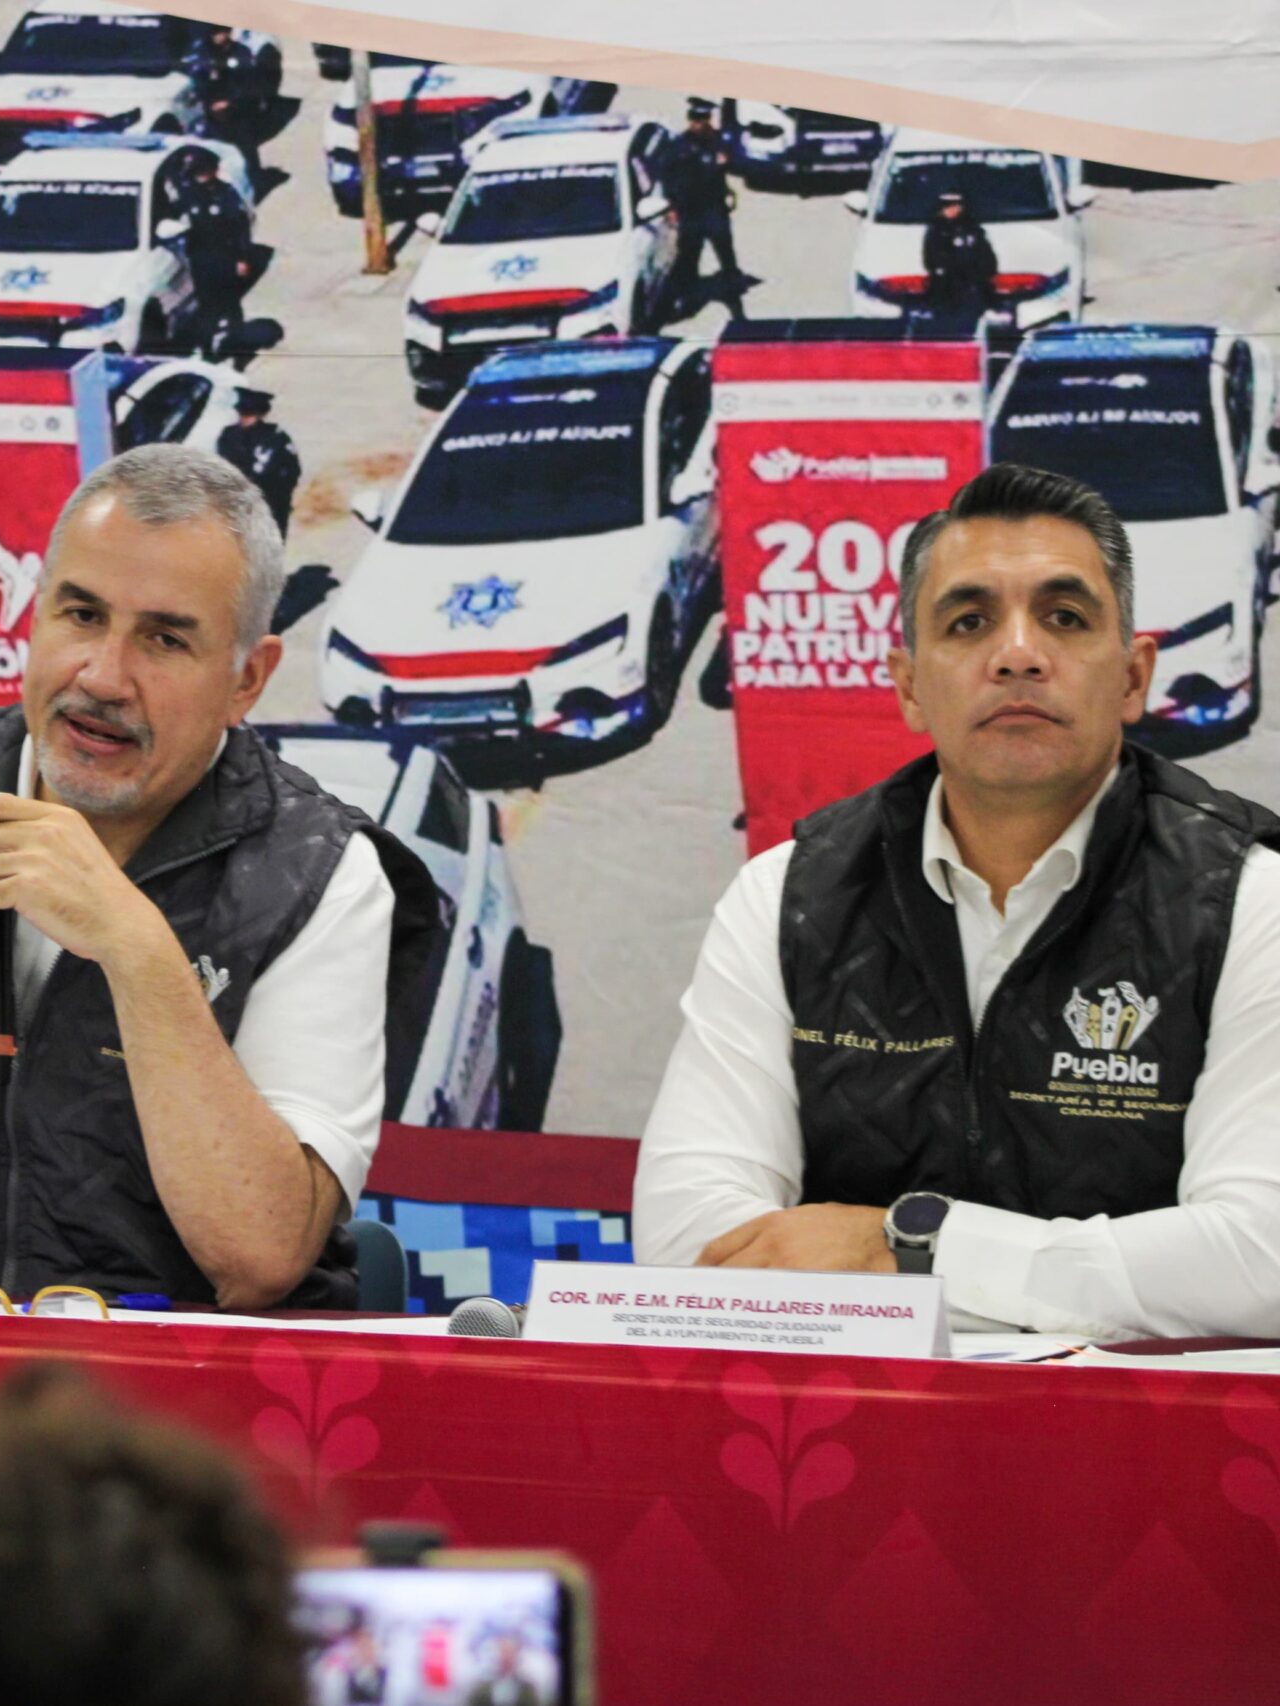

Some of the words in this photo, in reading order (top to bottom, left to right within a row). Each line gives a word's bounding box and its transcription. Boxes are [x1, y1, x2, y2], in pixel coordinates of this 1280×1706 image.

[744, 592, 903, 633] NUEV
[734, 665, 823, 687] PARA
[826, 665, 869, 687] LA
[833, 1030, 878, 1051] FÉLIX
[1051, 1051, 1159, 1084] Puebla
[1122, 1100, 1186, 1113] SEGURID
[549, 1290, 590, 1305] COR.
[595, 1292, 630, 1306] INF.
[634, 1294, 670, 1308] E.M.
[674, 1292, 726, 1311] FÉLIX
[730, 1298, 825, 1316] PALLARES
[828, 1303, 915, 1319] MIRANDA
[612, 1312, 686, 1326] SECRETARIO
[687, 1316, 703, 1326] DE
[704, 1317, 773, 1331] SEGURIDAD
[775, 1321, 844, 1333] CIUDADANA
[625, 1327, 648, 1337] DEL
[760, 1333, 776, 1344] DE
[777, 1335, 825, 1346] PUEBLA
